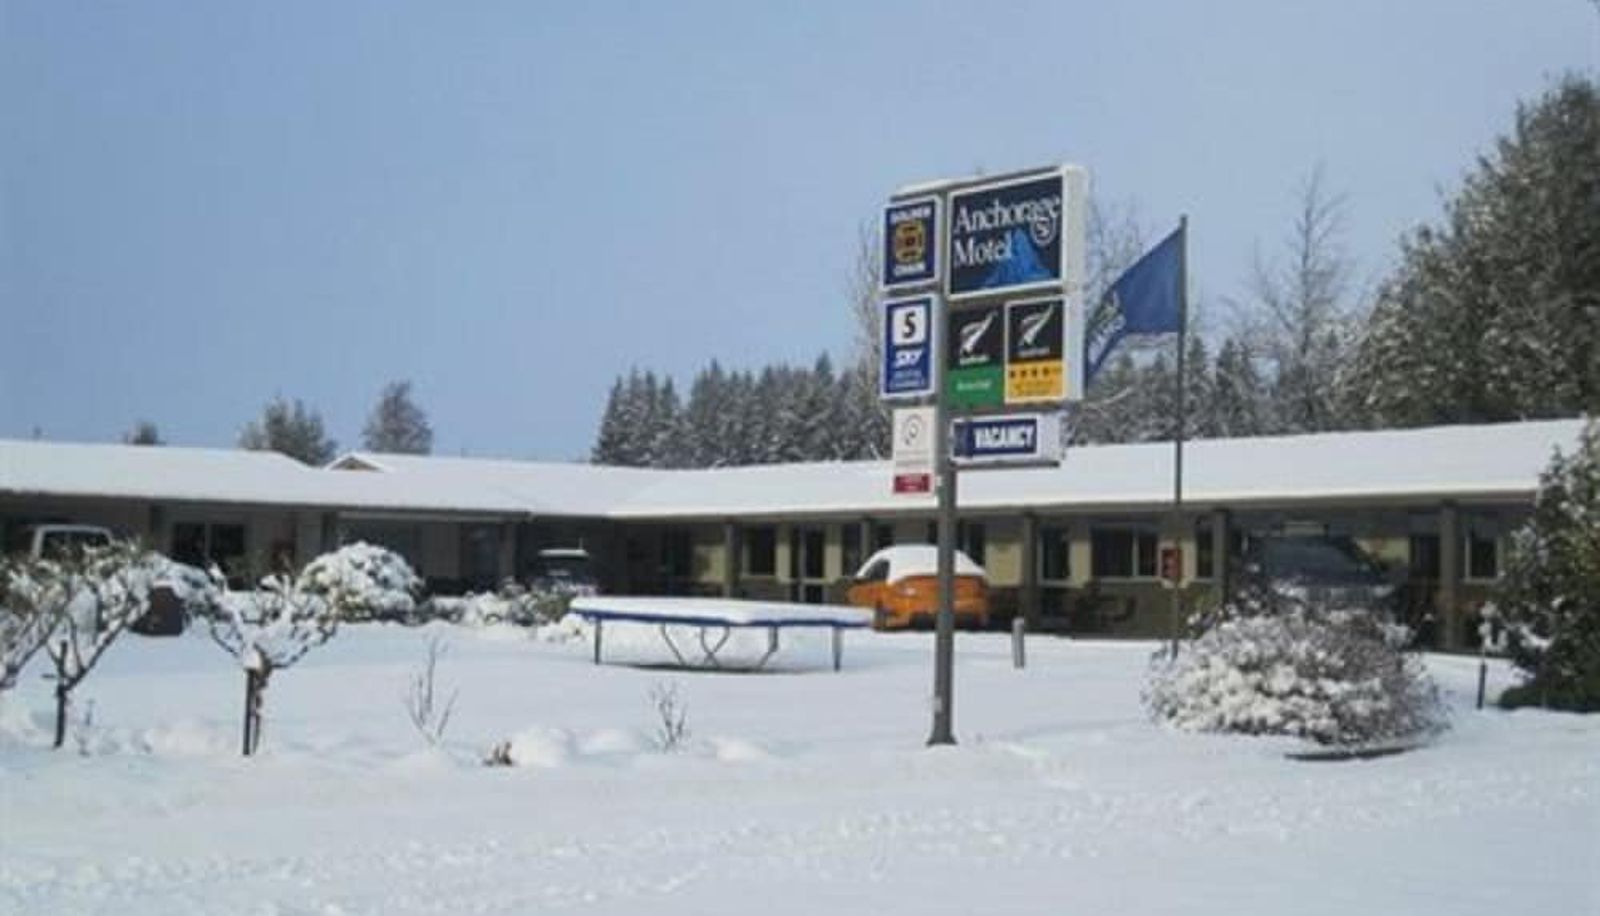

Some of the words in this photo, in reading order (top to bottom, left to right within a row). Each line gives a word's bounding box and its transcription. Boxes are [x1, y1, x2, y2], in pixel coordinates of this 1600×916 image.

[953, 196, 1061, 237] Anchorage
[953, 231, 1012, 268] Motel
[903, 310, 916, 339] 5
[974, 424, 1034, 449] VACANCY
